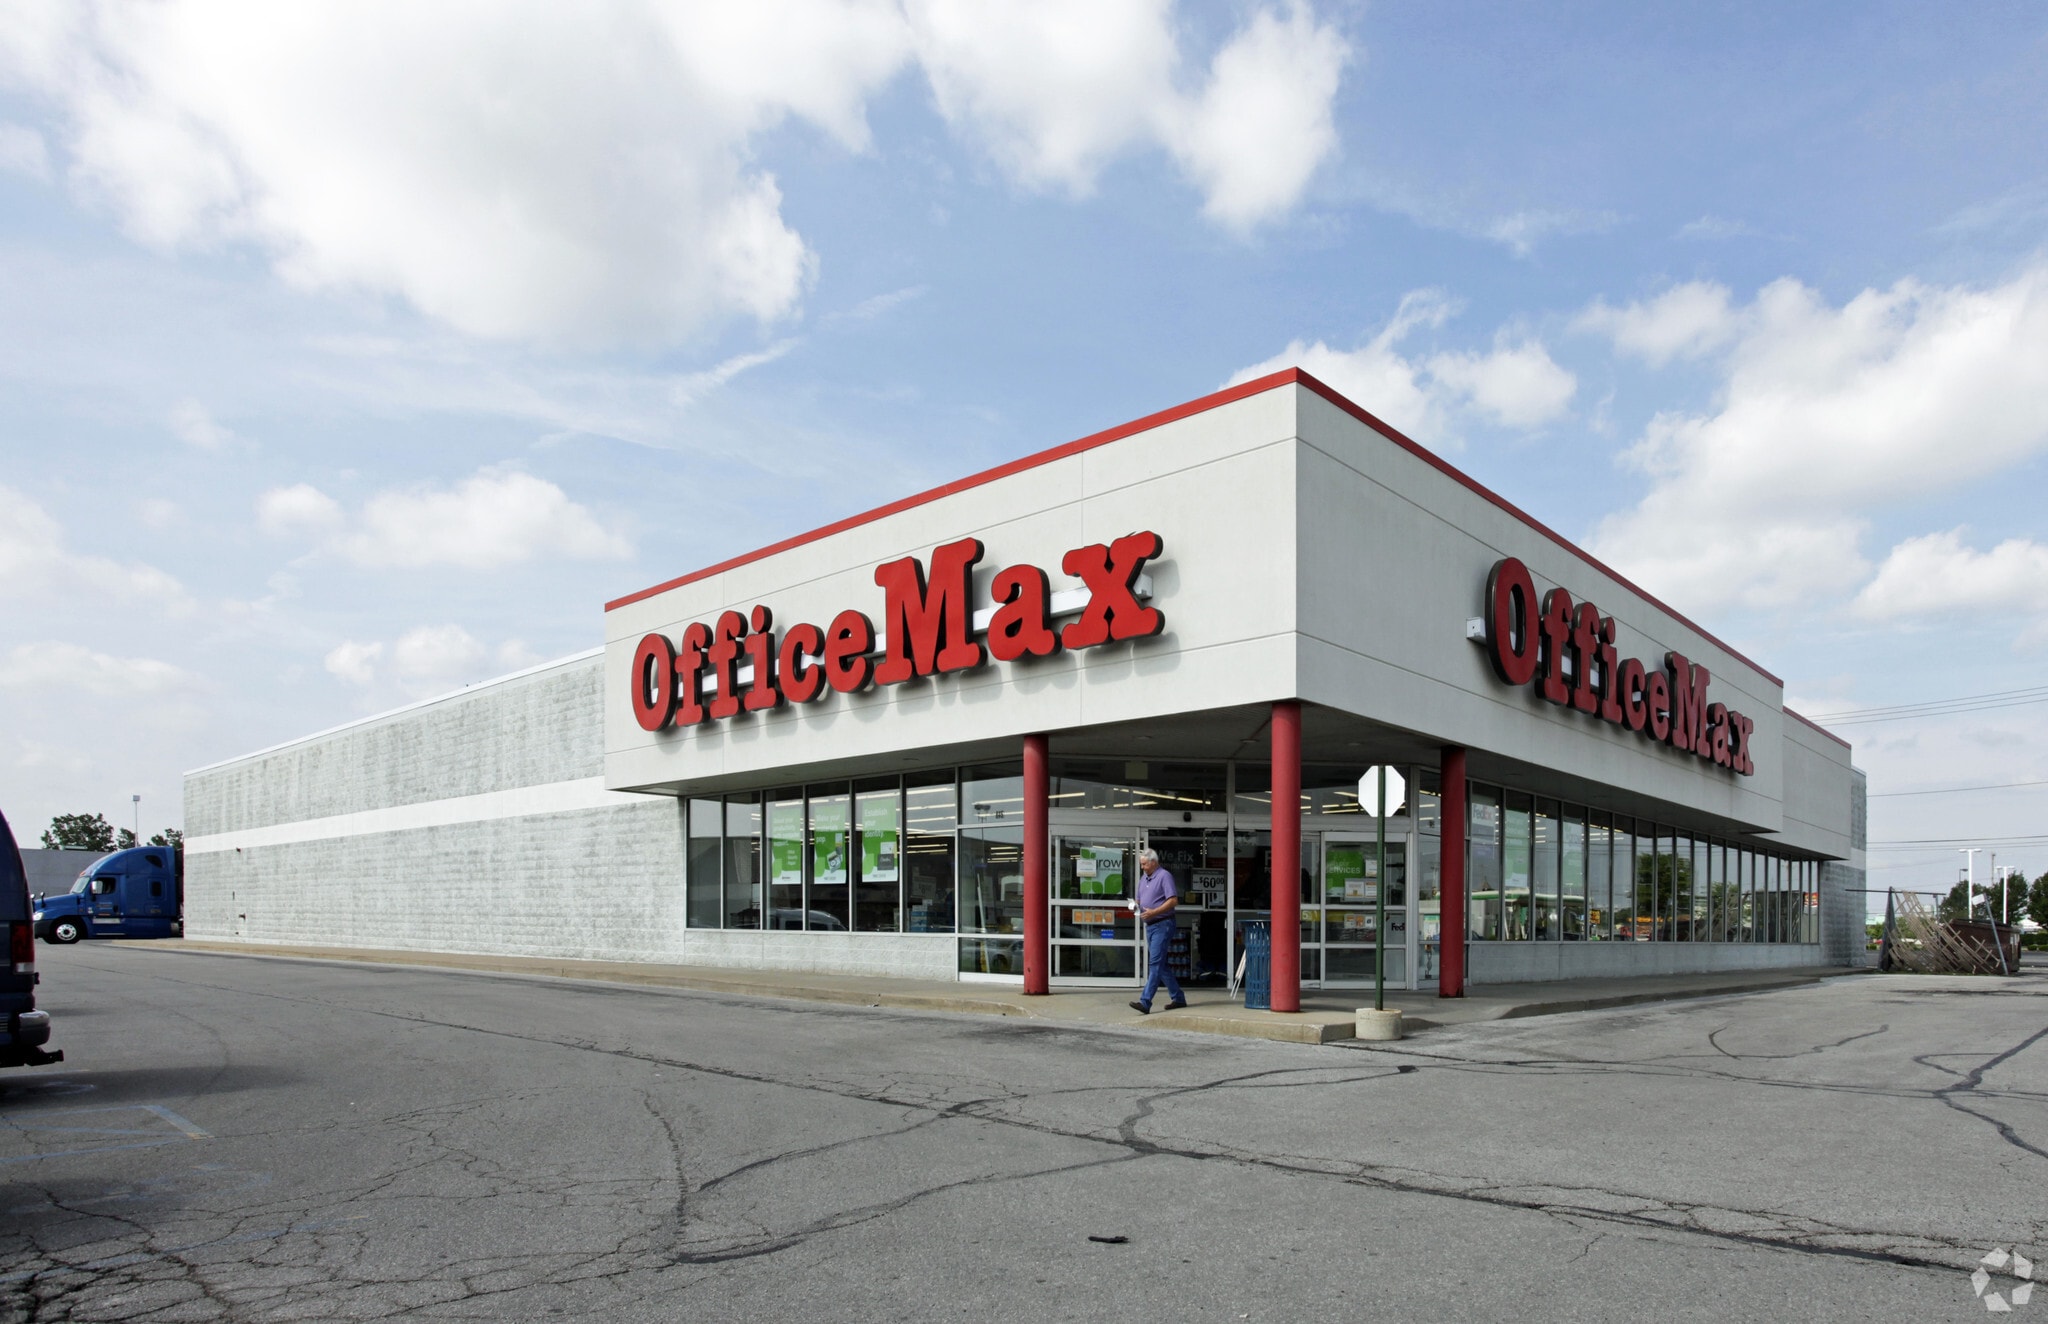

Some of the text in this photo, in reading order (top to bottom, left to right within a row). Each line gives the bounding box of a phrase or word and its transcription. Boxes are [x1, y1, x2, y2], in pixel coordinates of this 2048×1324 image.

[631, 531, 1164, 731] OfficeMax
[1485, 557, 1754, 776] OfficeMax
[1096, 859, 1122, 869] row
[1177, 850, 1194, 862] Fix
